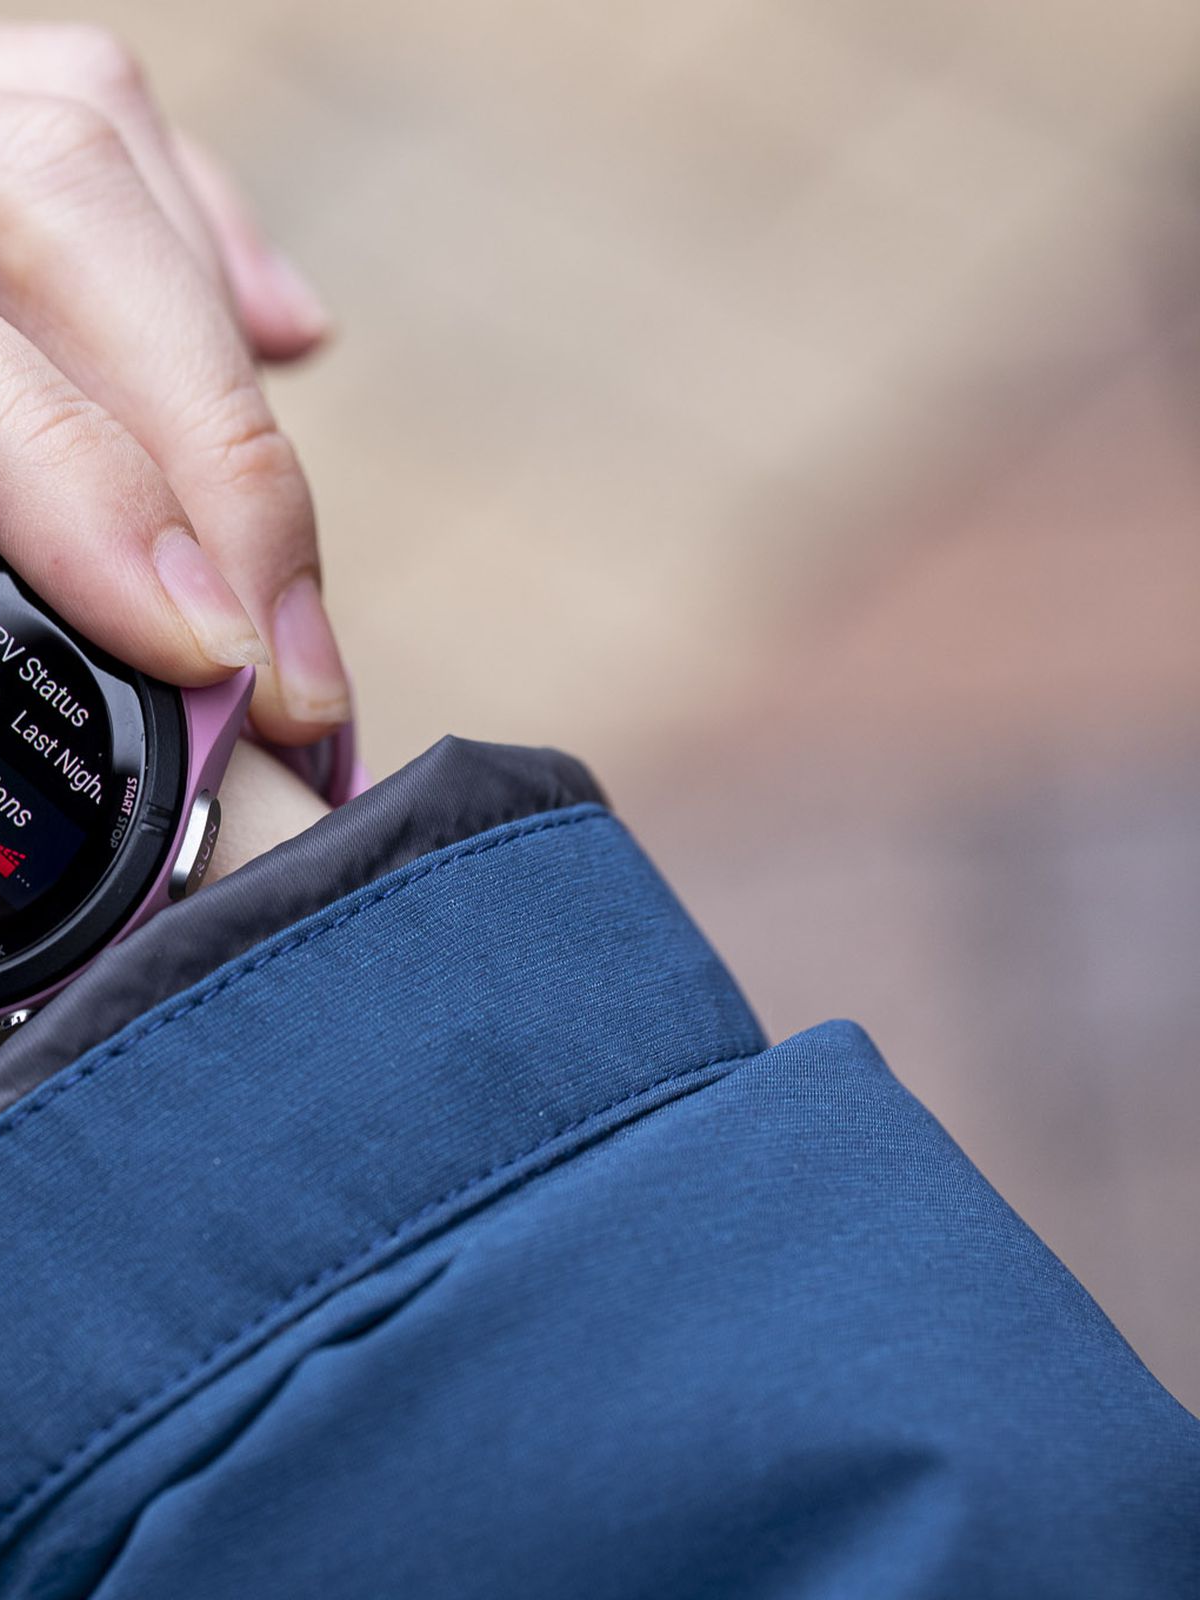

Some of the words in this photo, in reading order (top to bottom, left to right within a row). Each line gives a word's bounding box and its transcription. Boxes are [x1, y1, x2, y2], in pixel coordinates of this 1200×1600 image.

[18, 656, 90, 728] Status
[10, 710, 59, 759] Last
[121, 776, 138, 817] START
[110, 815, 129, 849] STOP
